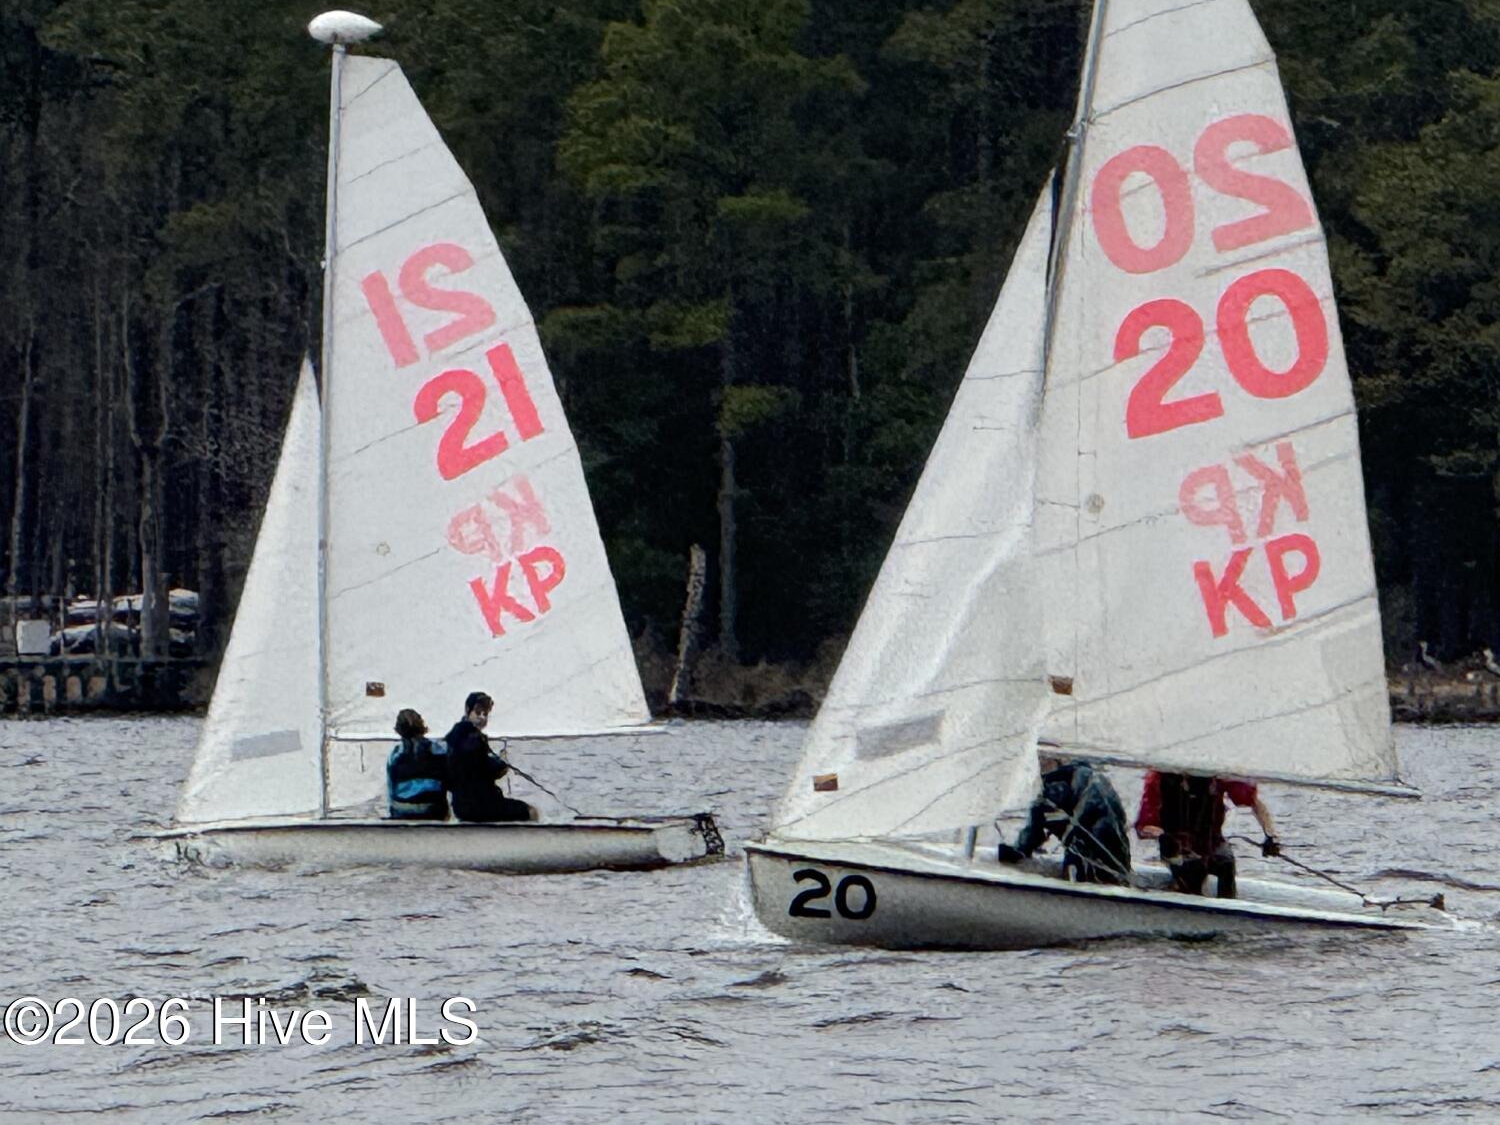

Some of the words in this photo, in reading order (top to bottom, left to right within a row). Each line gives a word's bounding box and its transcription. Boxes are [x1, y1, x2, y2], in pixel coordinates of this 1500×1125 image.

[1112, 266, 1330, 441] 20
[411, 340, 546, 482] 21
[469, 545, 567, 638] KP
[1191, 532, 1322, 639] KP
[788, 868, 878, 921] 20
